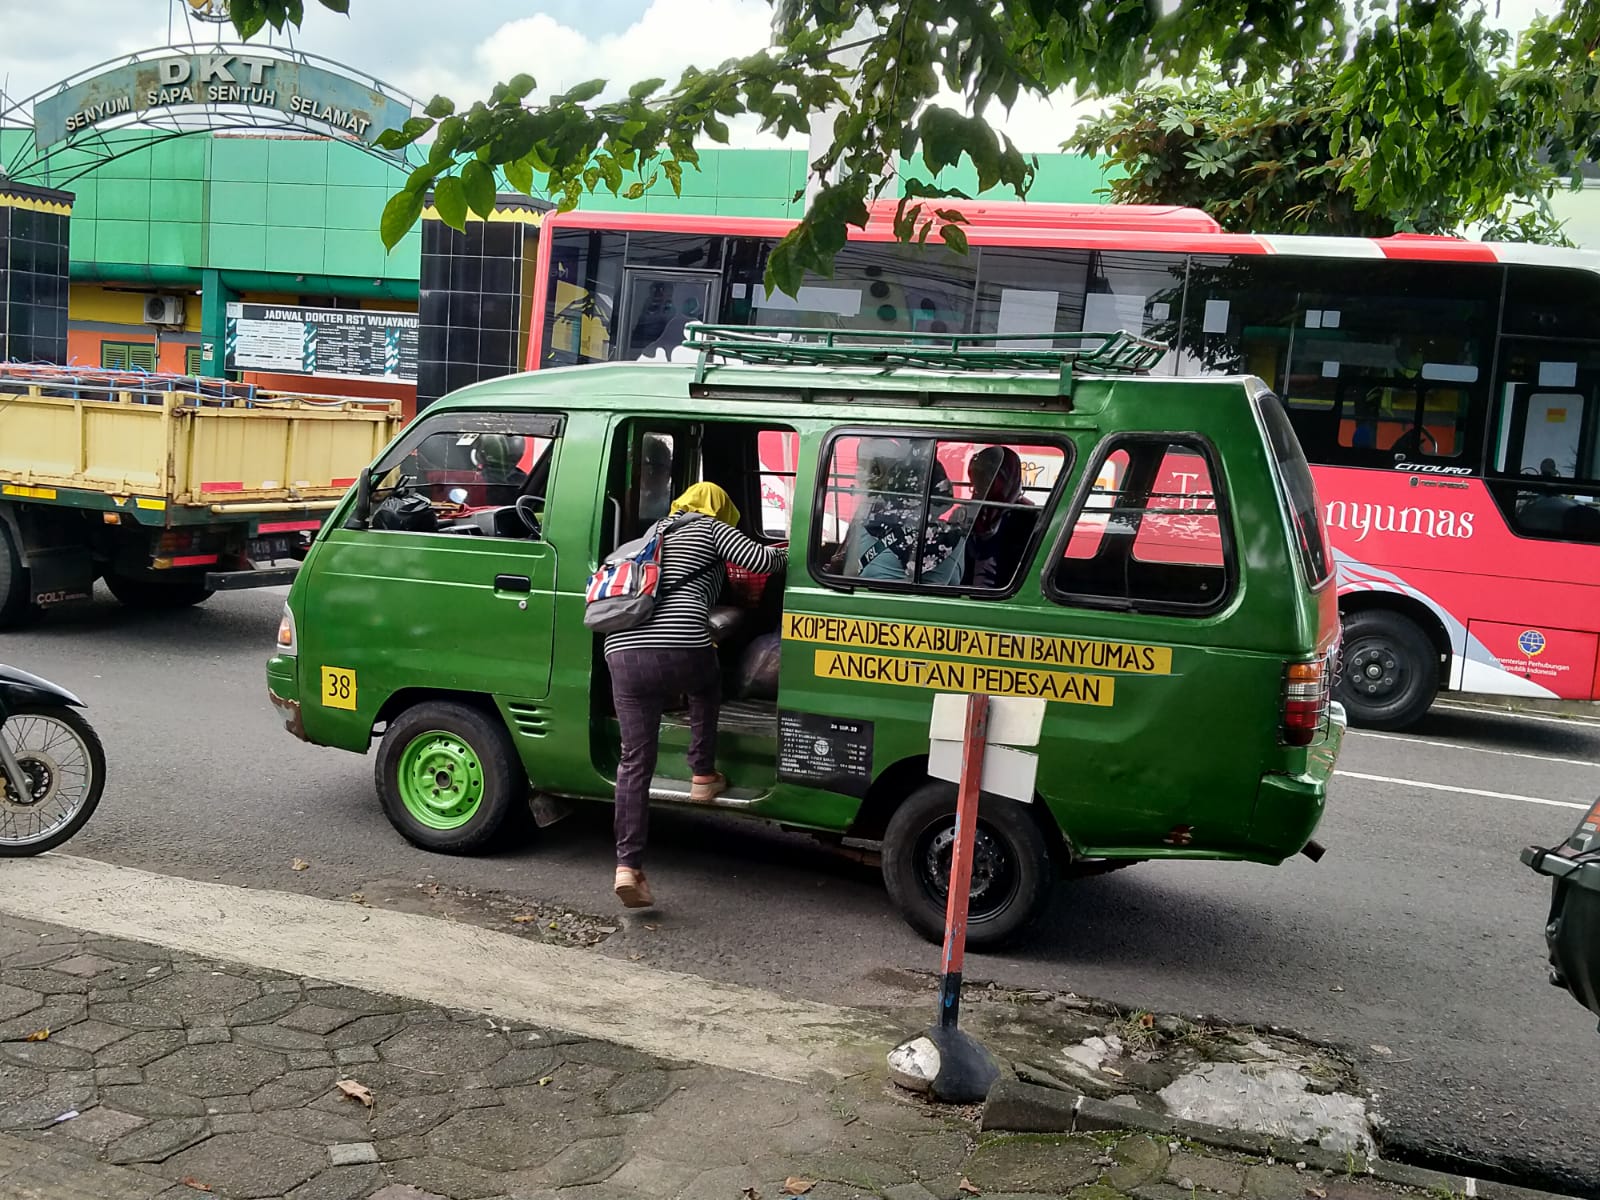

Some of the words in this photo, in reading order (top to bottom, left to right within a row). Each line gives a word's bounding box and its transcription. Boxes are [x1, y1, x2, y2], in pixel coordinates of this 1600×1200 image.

[159, 56, 275, 87] DKT
[65, 95, 131, 133] SENYUM
[146, 87, 194, 107] SAPA
[207, 86, 277, 106] SENTUH
[289, 95, 372, 136] SELAMAT
[263, 309, 303, 322] JADWAL
[305, 312, 343, 325] DOKTER
[345, 313, 366, 325] RST
[367, 315, 419, 329] WIJAYAKU
[1394, 462, 1473, 476] CITOURO
[881, 532, 898, 548] YSL
[36, 591, 66, 605] COLT
[790, 615, 901, 648] KOPERADES
[903, 623, 1025, 660] KABUPATEN
[1029, 637, 1156, 672] BANYUMAS
[328, 673, 351, 700] 38
[828, 654, 965, 689] ANGKUTAN
[972, 667, 1101, 703] PEDESAAN
